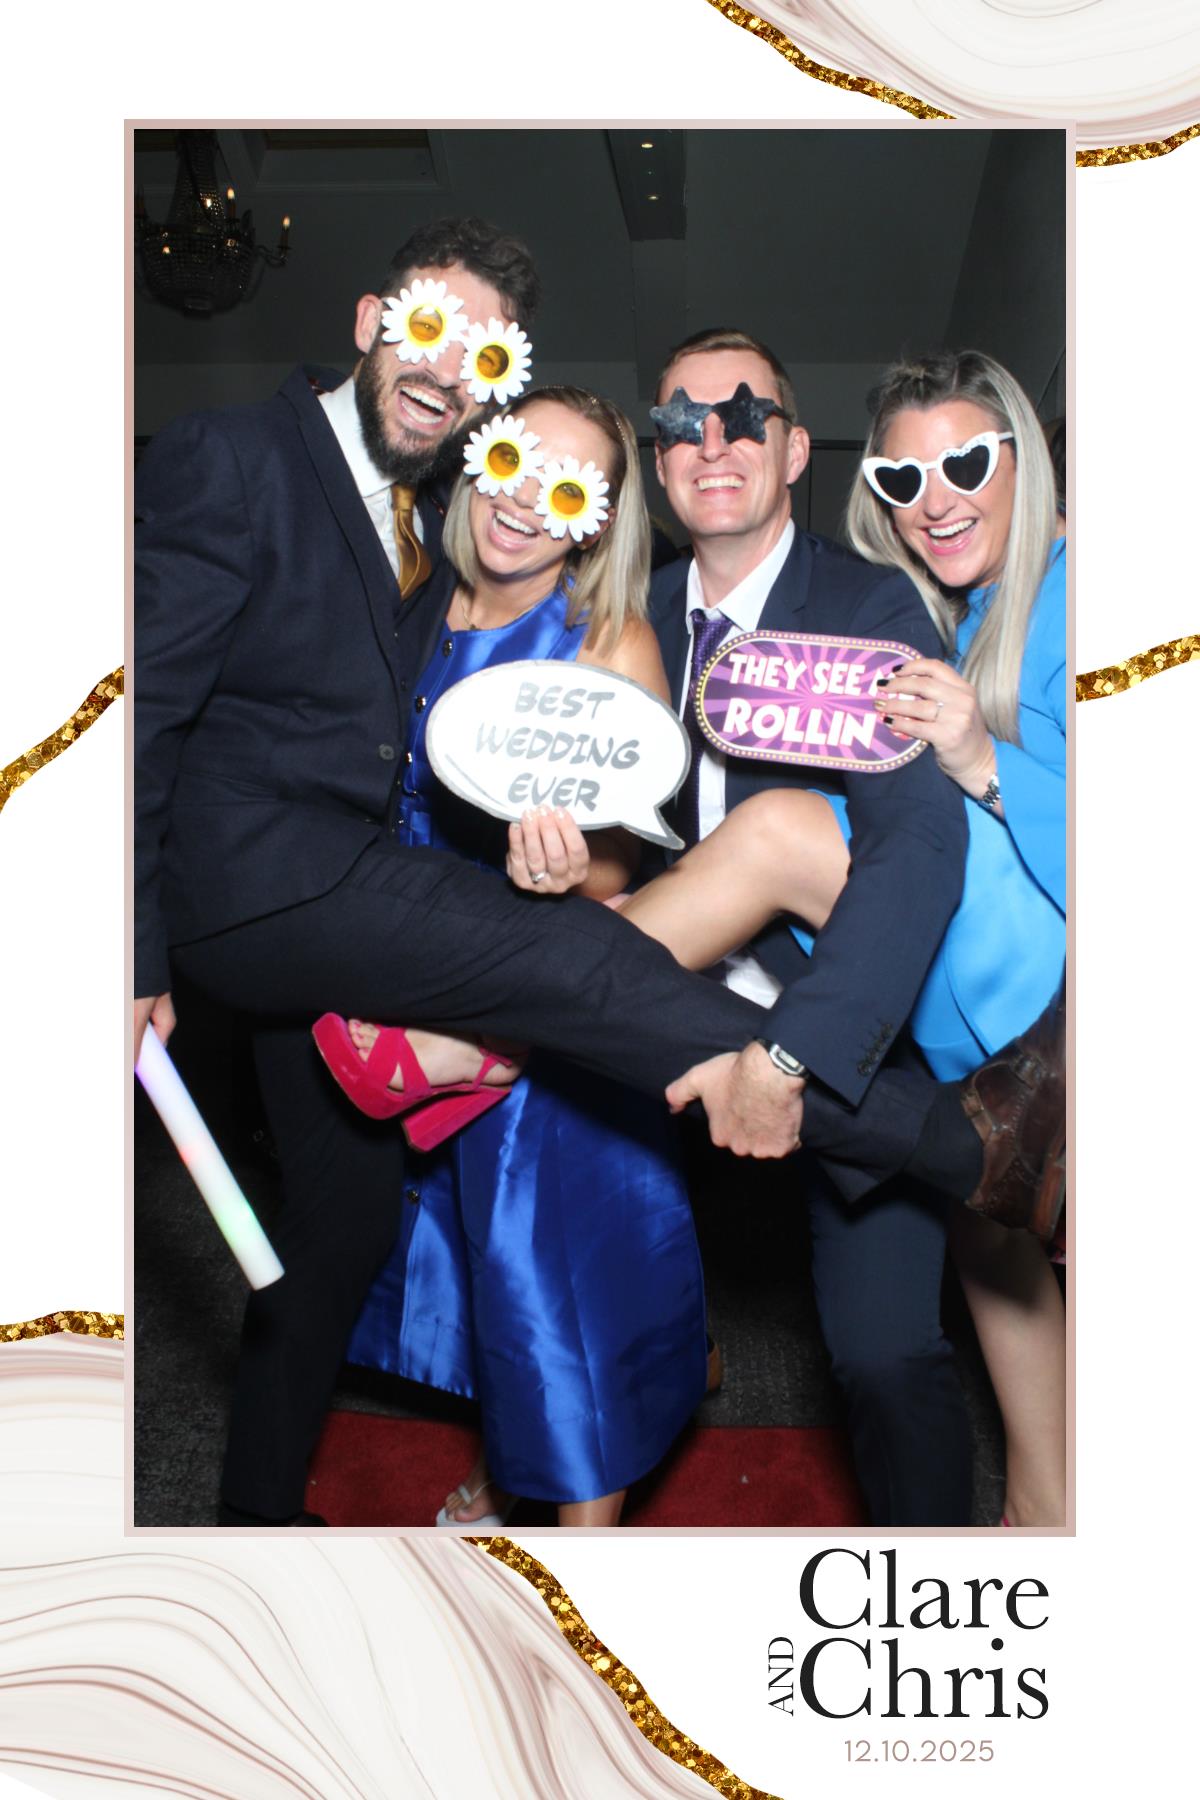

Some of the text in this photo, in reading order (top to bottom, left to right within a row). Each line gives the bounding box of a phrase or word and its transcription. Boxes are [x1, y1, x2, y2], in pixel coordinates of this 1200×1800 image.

[729, 653, 807, 690] THEY
[811, 661, 866, 696] SEE
[515, 682, 615, 720] BEST
[722, 697, 877, 749] ROLLIN
[476, 722, 640, 769] WEDDING
[507, 772, 600, 812] EVER
